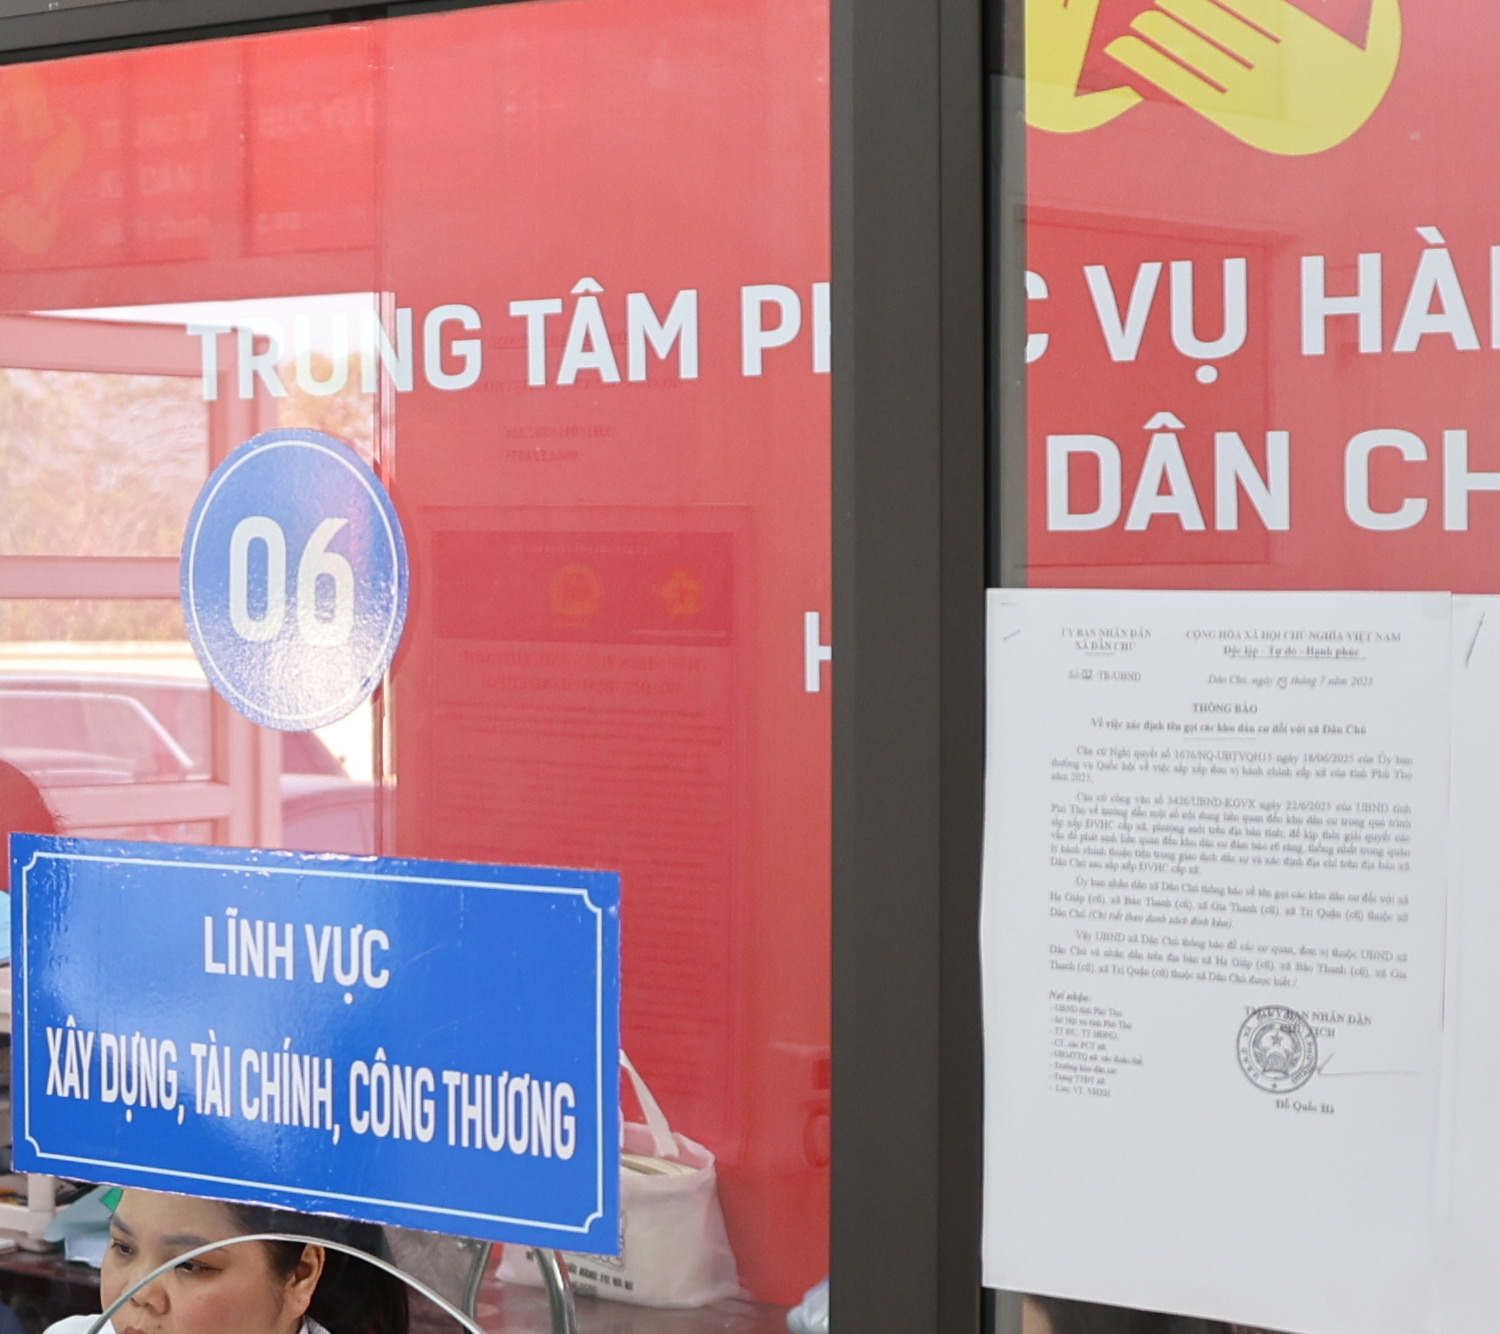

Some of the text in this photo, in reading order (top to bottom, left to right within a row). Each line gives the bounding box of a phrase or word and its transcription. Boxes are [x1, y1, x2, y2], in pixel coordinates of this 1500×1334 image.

[186, 304, 482, 400] TRUNG
[509, 277, 699, 386] TÂM
[1083, 259, 1249, 383] VỤ
[1047, 412, 1290, 532] DÂN
[228, 515, 355, 648] 06
[1192, 701, 1232, 714] THÔNG
[205, 909, 389, 1004] LĨNH VỰC
[45, 1016, 576, 1161] XÂY DỰNG, TÀI CHÍNH, CÔNG THƯƠNG
